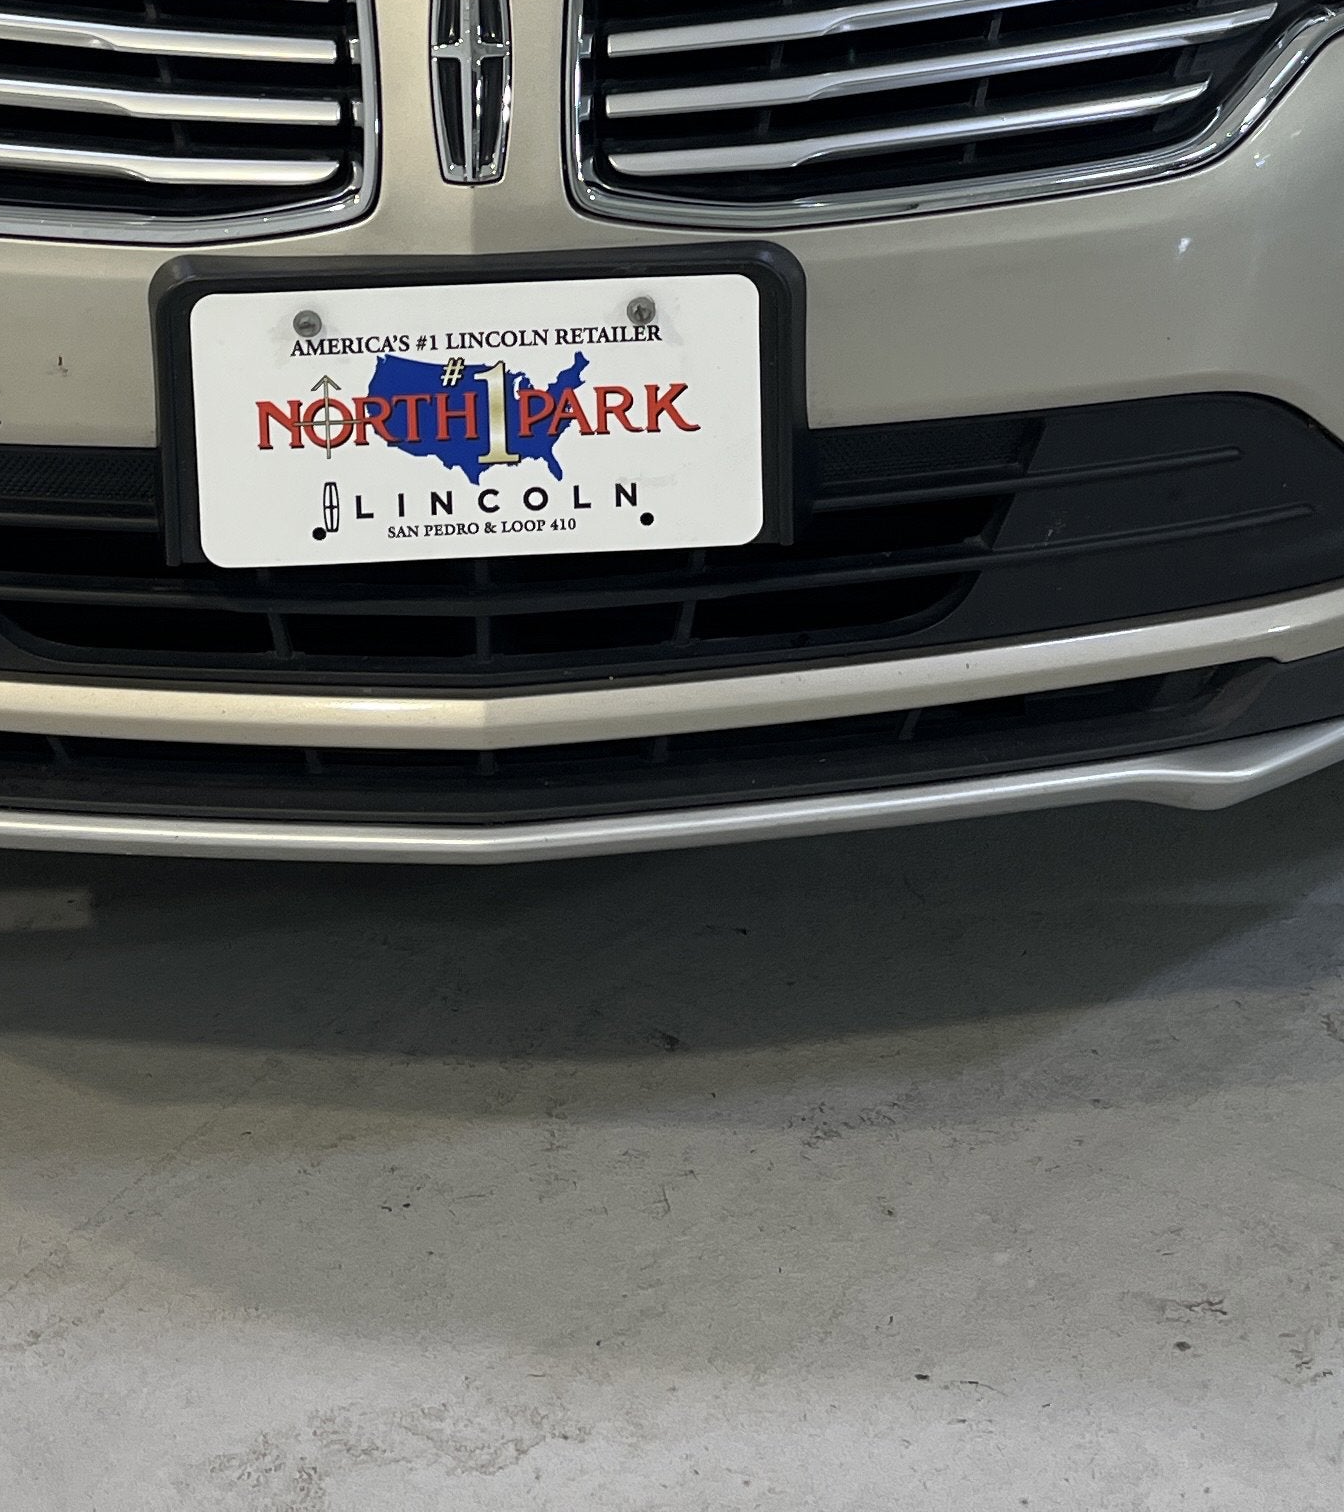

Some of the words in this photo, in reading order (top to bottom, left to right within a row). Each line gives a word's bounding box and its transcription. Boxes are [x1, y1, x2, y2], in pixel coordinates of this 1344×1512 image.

[290, 335, 410, 358] AMERICA'S
[415, 334, 439, 352] #1
[445, 328, 549, 350] LINCOLN
[554, 324, 663, 346] RETAILER
[255, 390, 479, 451] NORTH
[517, 382, 701, 438] PARK
[355, 482, 638, 519] LINCOLN
[387, 525, 419, 539] SAN
[424, 522, 480, 537] PEDRO
[484, 522, 497, 534] &
[501, 519, 546, 533] LOOP
[550, 518, 577, 531] 410
